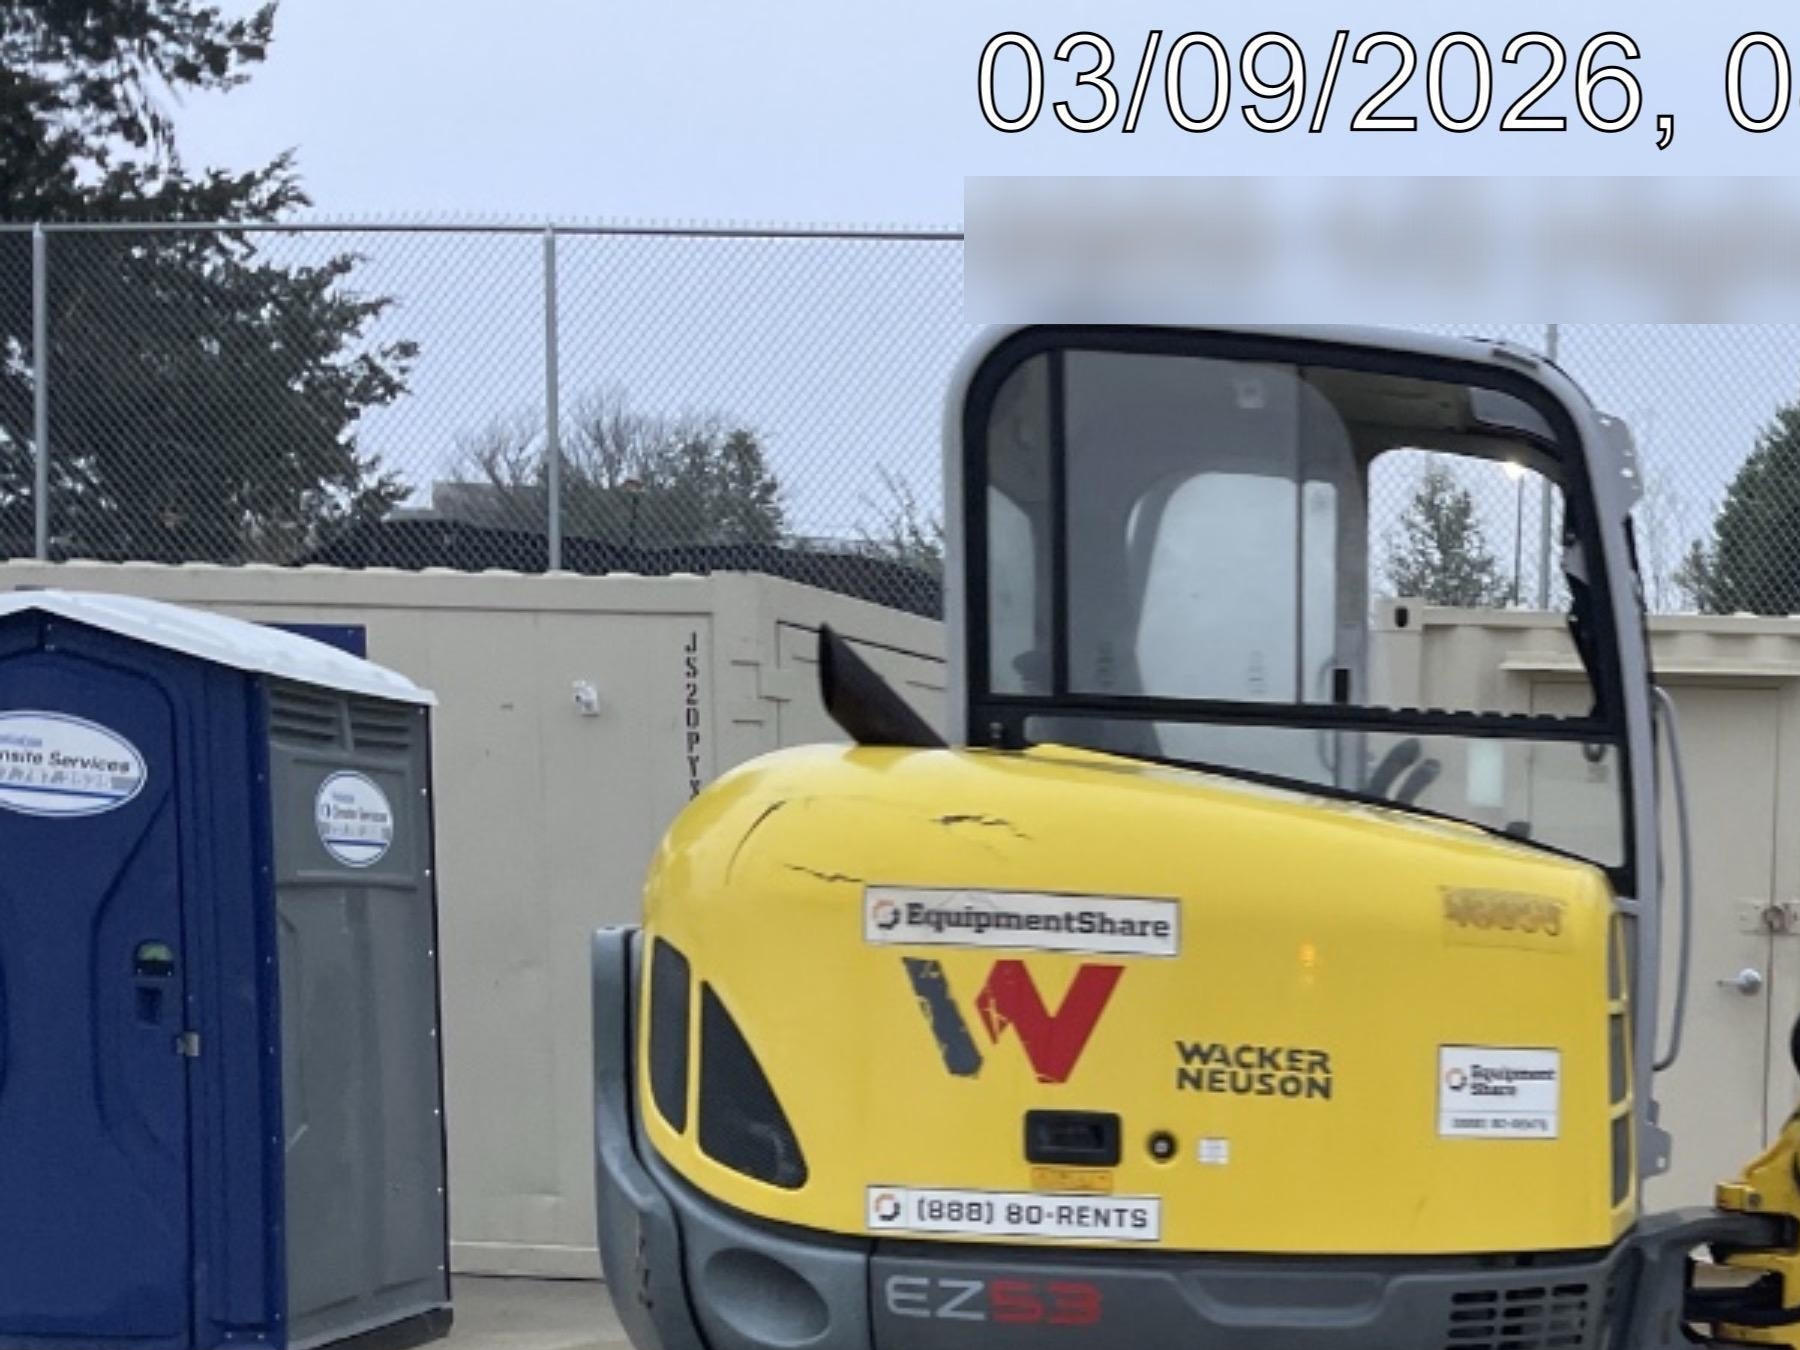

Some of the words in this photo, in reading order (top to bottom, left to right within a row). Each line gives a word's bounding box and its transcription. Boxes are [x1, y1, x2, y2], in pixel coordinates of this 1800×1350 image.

[905, 902, 1171, 937] EquipmentShare
[1175, 1040, 1332, 1075] WACKER
[1175, 1067, 1333, 1100] NEUSON
[917, 1197, 994, 1225] (888)
[1006, 1204, 1148, 1229] 80-RENTS
[885, 1275, 1101, 1325] EZ53
